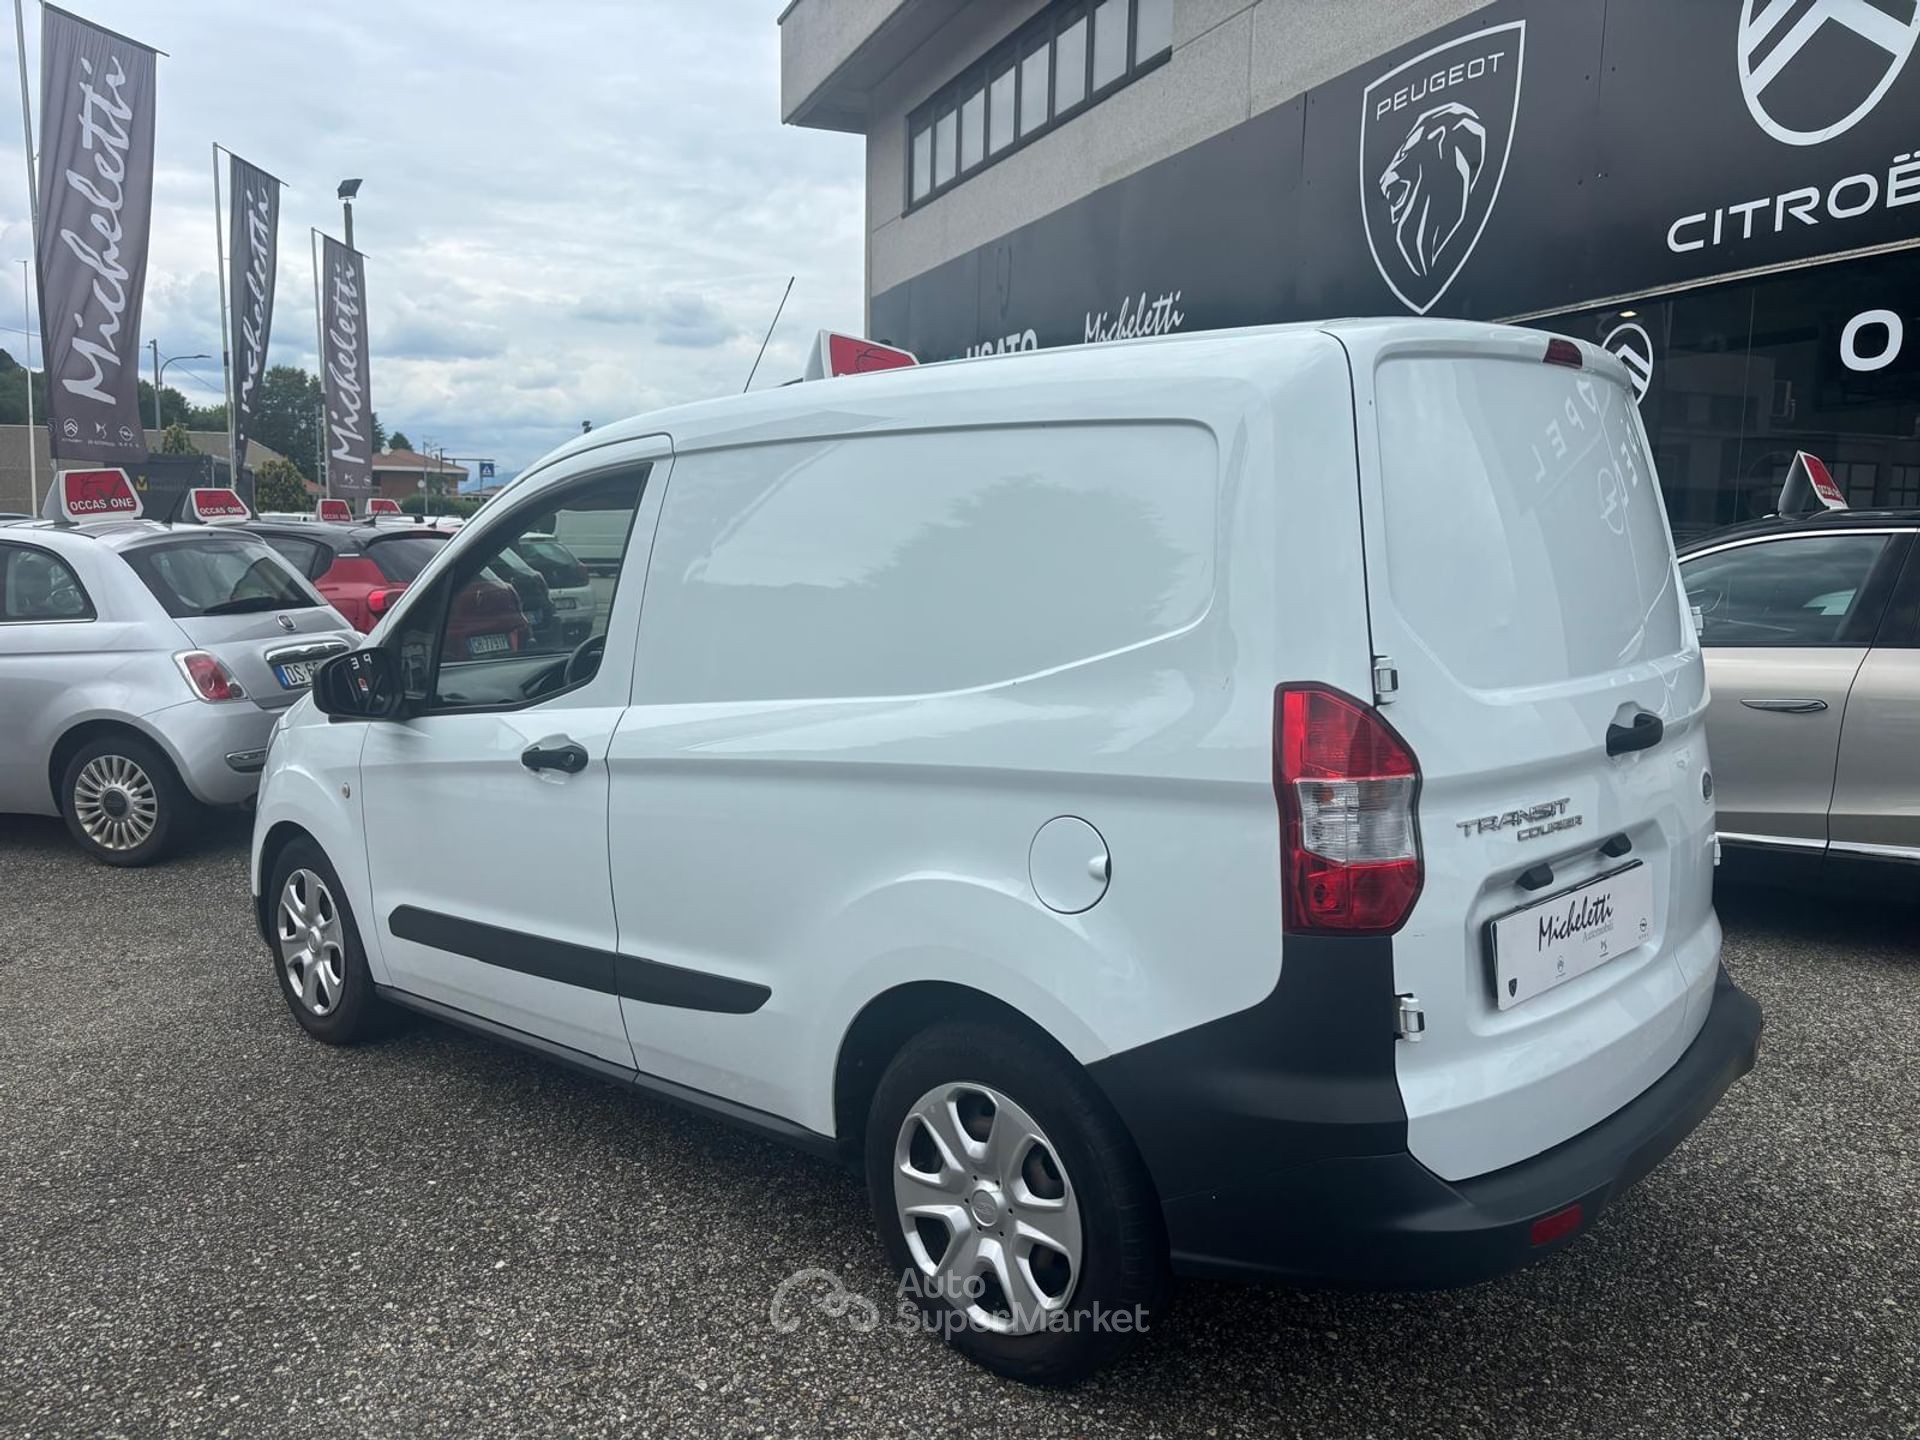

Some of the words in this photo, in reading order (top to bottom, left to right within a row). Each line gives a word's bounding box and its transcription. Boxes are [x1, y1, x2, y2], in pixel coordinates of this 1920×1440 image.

[1376, 52, 1505, 121] PEUGEOT
[60, 55, 133, 405] Micheletti
[1084, 290, 1186, 345] Micheletti
[1840, 309, 1904, 371] O
[328, 262, 366, 465] Micheletti
[69, 499, 107, 512] OCCAS
[110, 497, 135, 508] ONE
[200, 506, 226, 516] OCCAS
[227, 505, 245, 515] ONE
[1456, 797, 1571, 838] TRANSIT
[1517, 814, 1583, 842] COURIER
[1538, 893, 1614, 952] Micheletti
